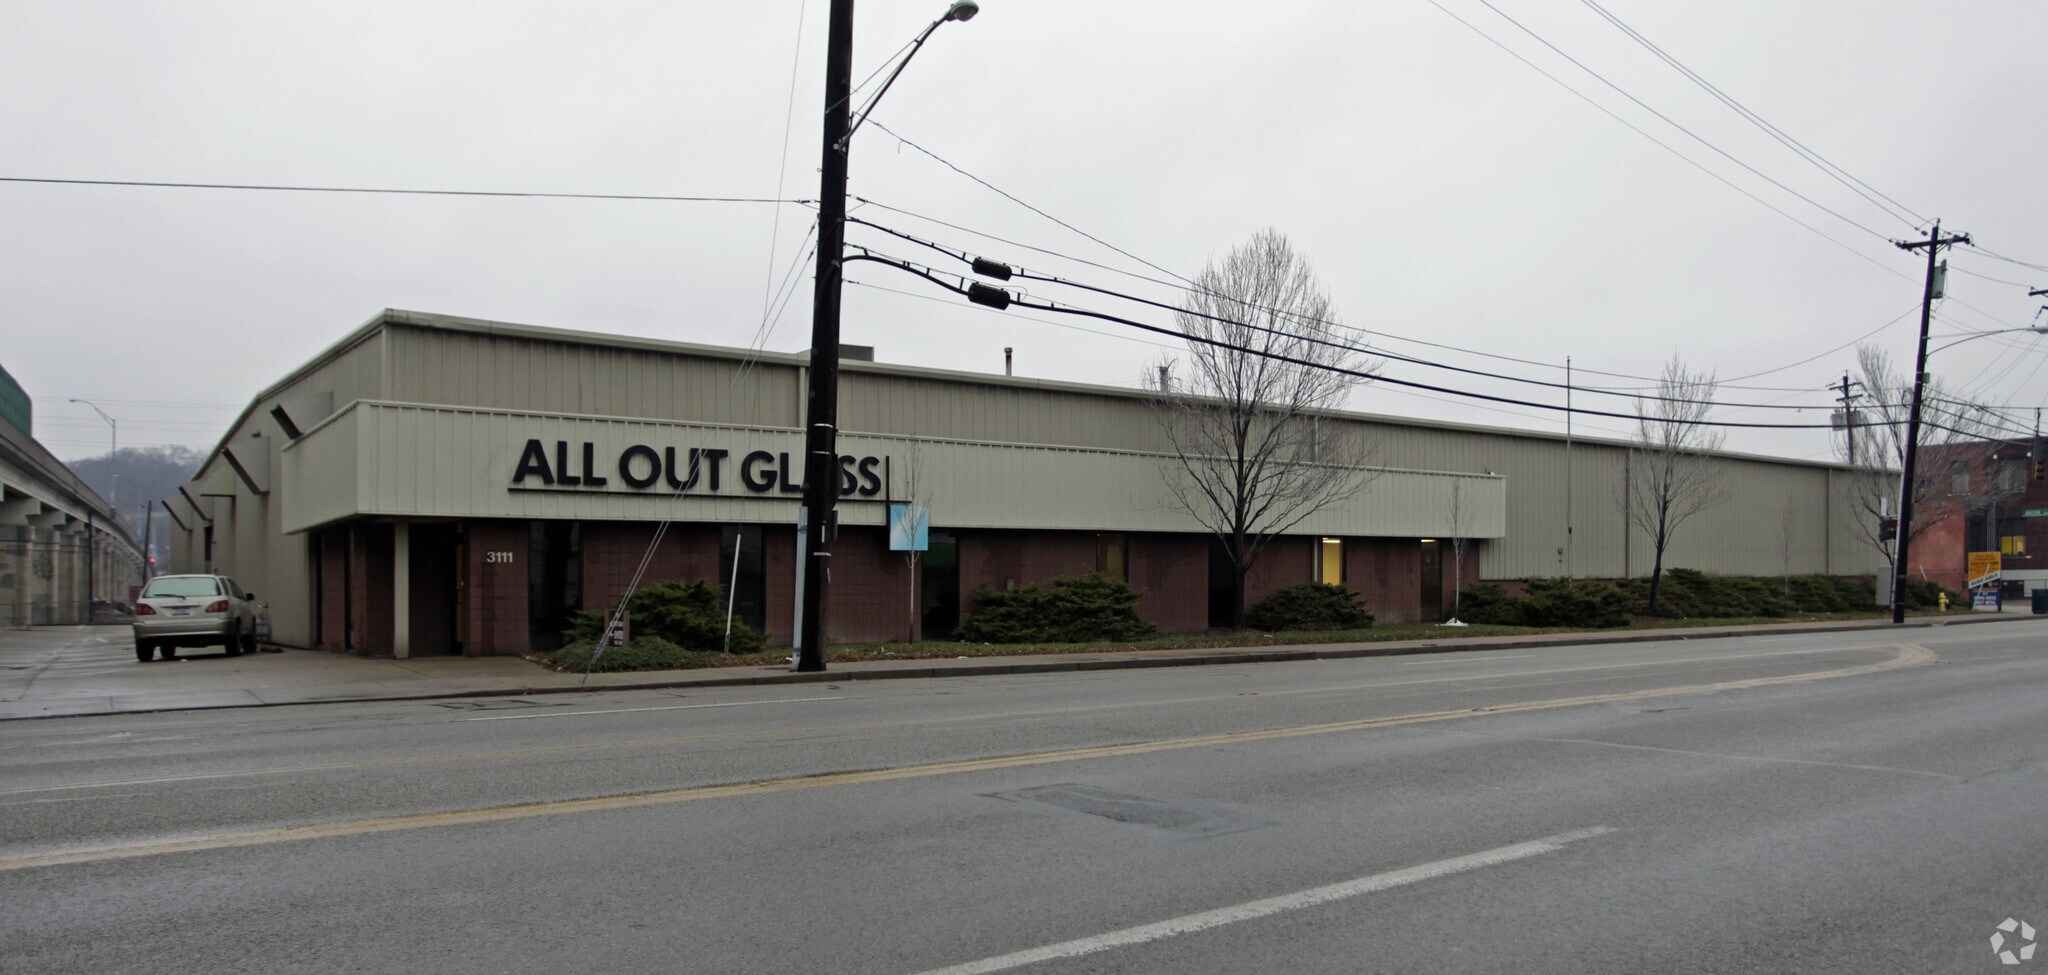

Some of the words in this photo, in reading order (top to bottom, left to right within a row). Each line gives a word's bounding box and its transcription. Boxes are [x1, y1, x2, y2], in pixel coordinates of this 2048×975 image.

[512, 439, 607, 485] ALL
[619, 444, 729, 491] OUT
[741, 450, 882, 496] GLSS
[486, 551, 514, 563] 3111
